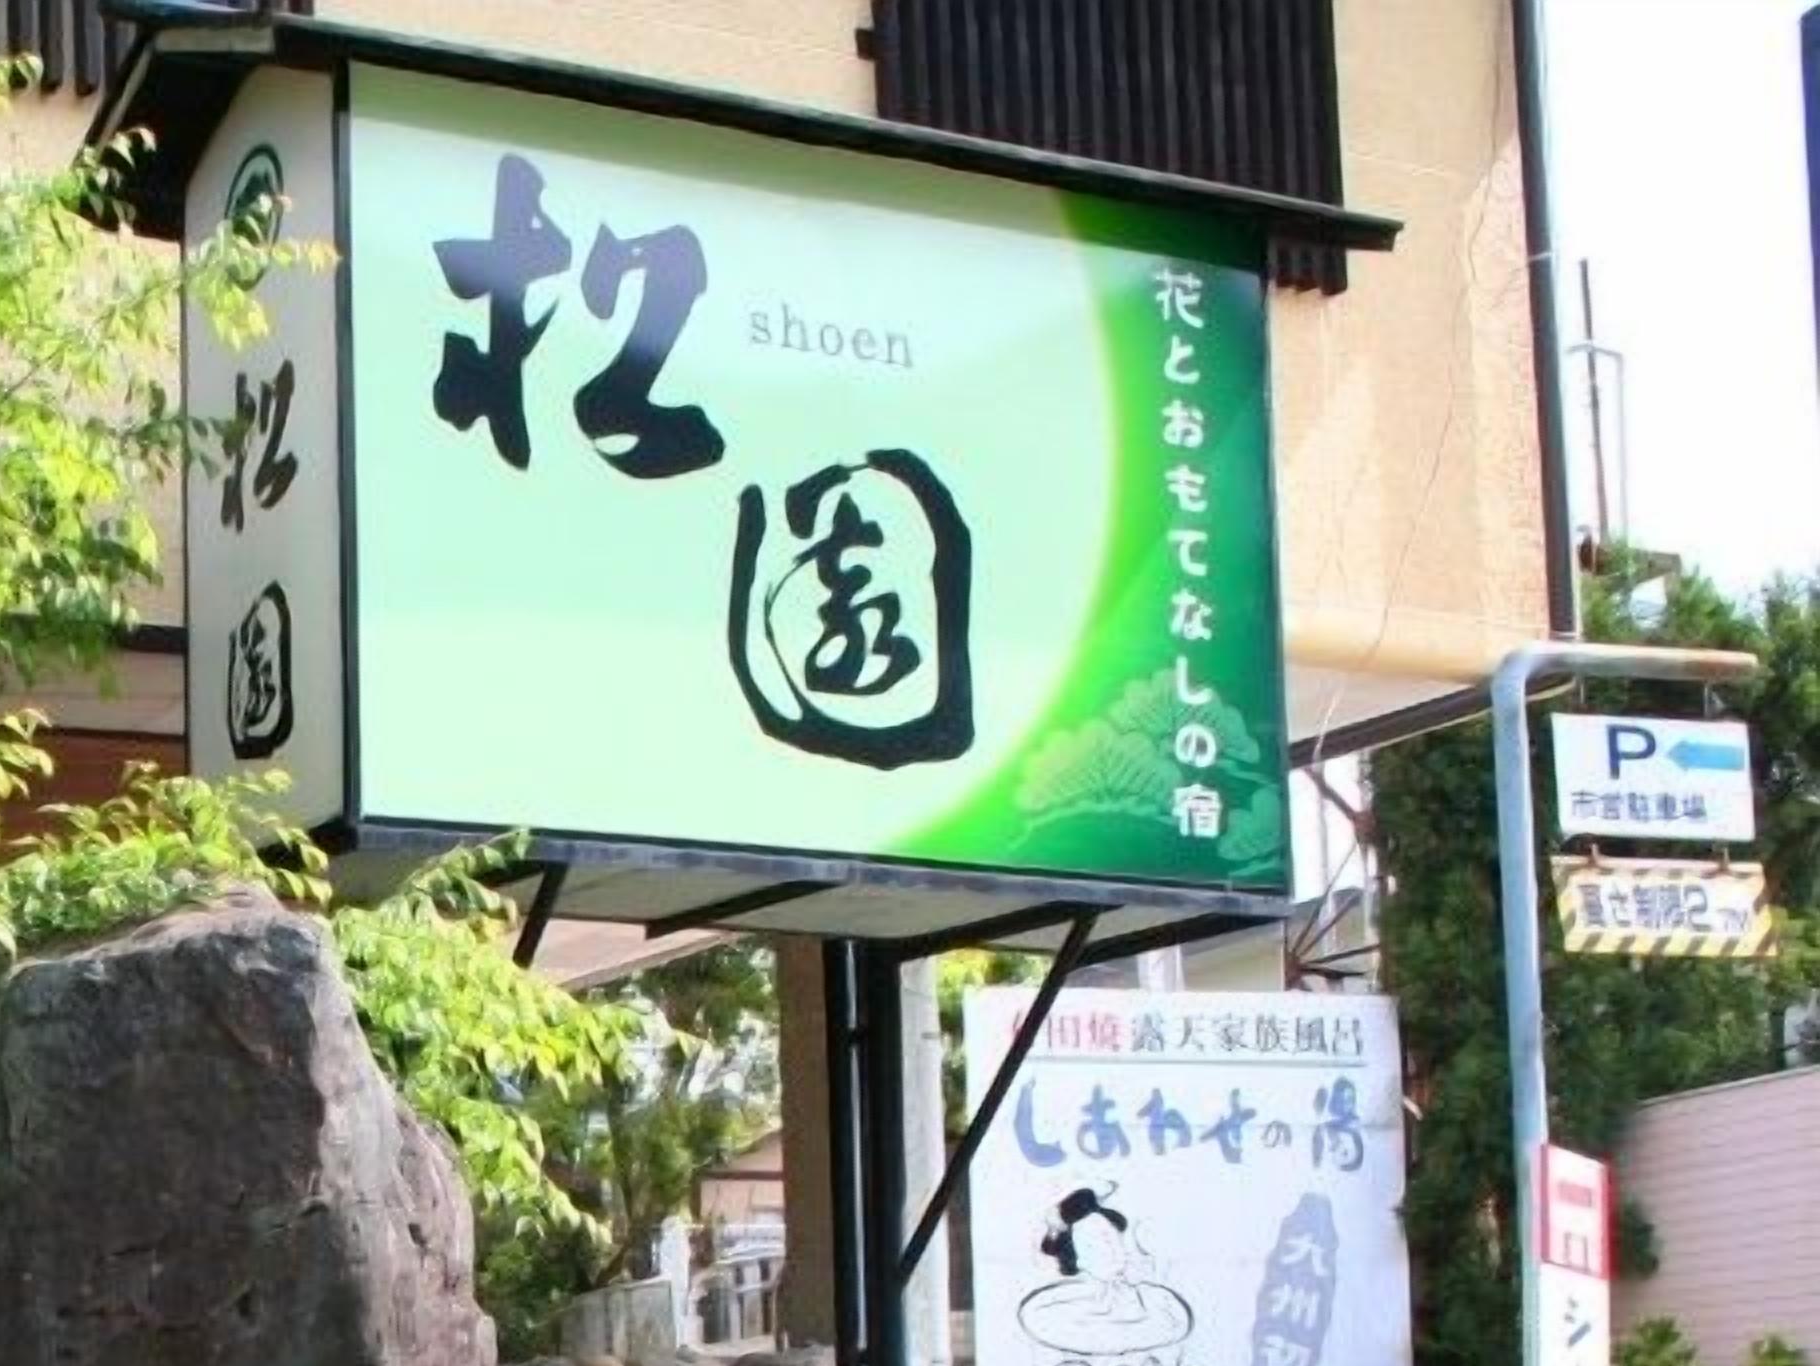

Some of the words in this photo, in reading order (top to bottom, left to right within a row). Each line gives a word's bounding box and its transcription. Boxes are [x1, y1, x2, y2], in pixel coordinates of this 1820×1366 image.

[750, 302, 914, 368] shoen
[1155, 268, 1223, 838] 花とおもてなしの宿
[1605, 723, 1658, 780] P
[1012, 1008, 1366, 1057] 田焼露天家族風呂
[1012, 1074, 1366, 1172] しあわせの湯
